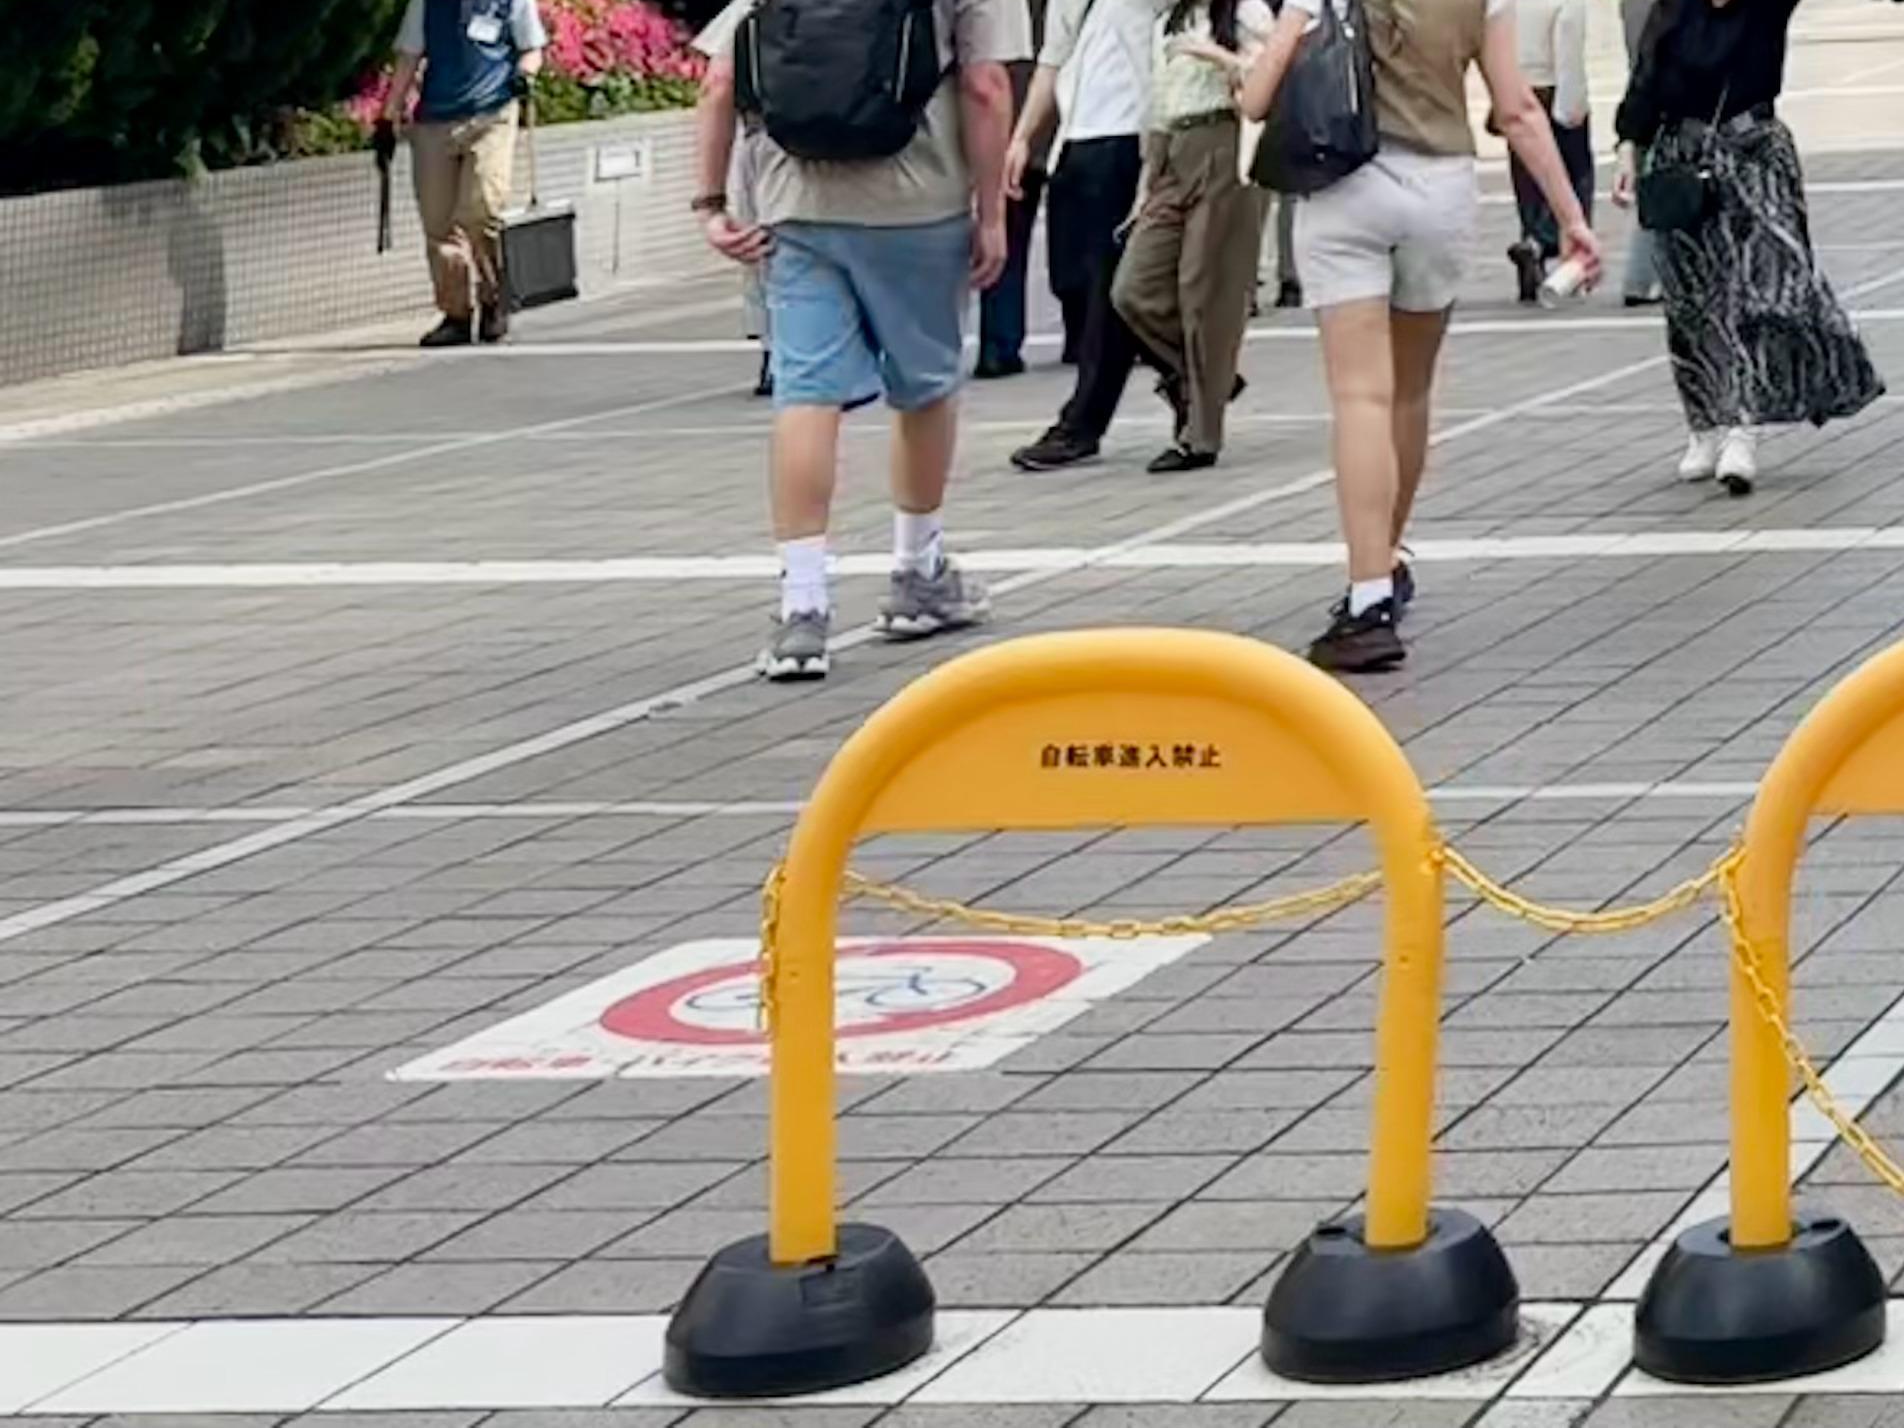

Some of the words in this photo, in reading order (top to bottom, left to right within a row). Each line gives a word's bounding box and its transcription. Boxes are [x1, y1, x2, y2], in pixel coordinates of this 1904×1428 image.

[1040, 743, 1222, 769] 自転車進入禁止
